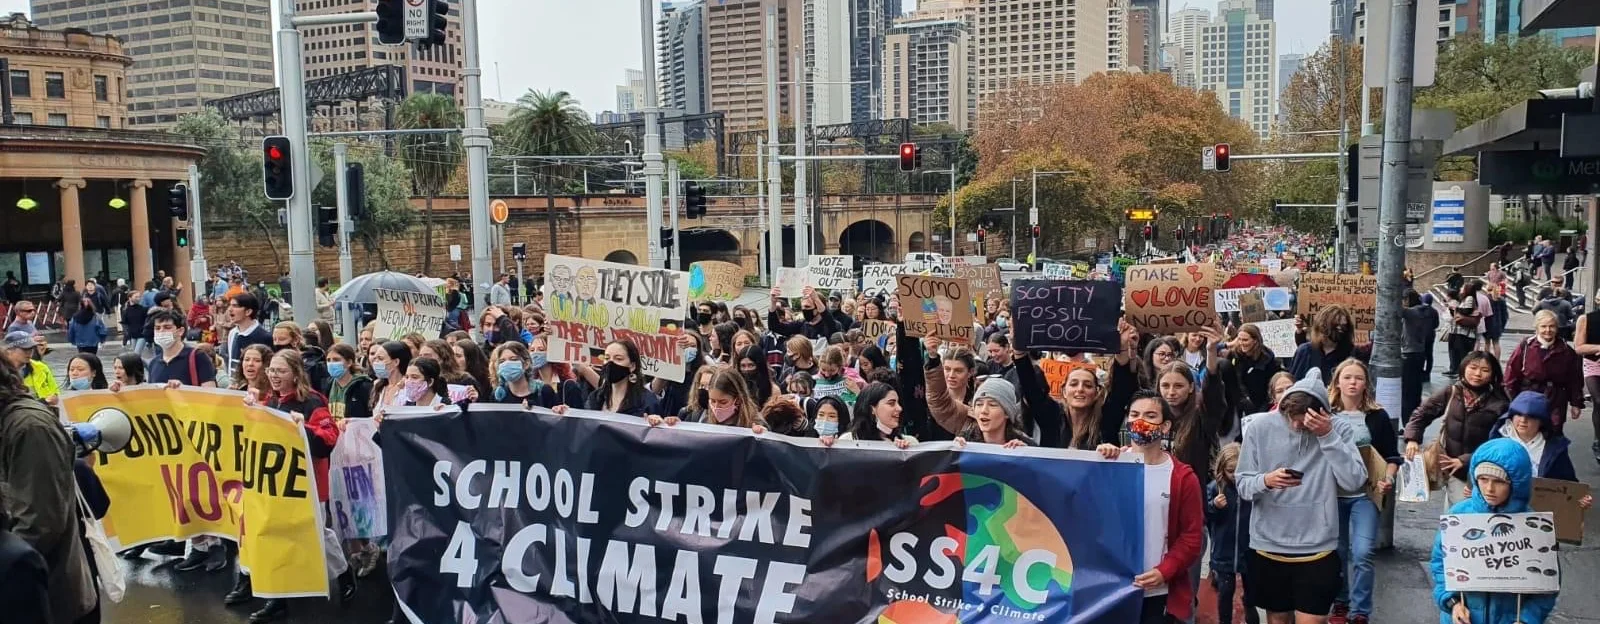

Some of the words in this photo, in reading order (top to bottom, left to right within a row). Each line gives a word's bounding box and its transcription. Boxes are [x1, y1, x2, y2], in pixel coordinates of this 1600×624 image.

[409, 9, 422, 18] NO
[818, 256, 844, 267] VOTE
[810, 267, 831, 276] FOSSIL
[864, 265, 909, 277] FRACK
[957, 266, 998, 280] SYSTEM
[1129, 267, 1180, 281] MAKE
[598, 268, 640, 305] THEY
[637, 269, 681, 309] STOLE
[818, 278, 842, 288] OUT
[875, 279, 892, 287] OFF
[900, 276, 961, 301] SCOMO
[970, 279, 993, 289] ANGE
[863, 287, 892, 297] GA
[1015, 285, 1095, 304] SCOTTY
[1150, 286, 1211, 307] LOVE
[413, 293, 443, 307] DRINK
[1222, 300, 1238, 311] ASS
[614, 306, 625, 327] &
[628, 307, 661, 334] NOW
[1017, 306, 1093, 321] FOSSIL
[904, 320, 928, 334] LIKES
[933, 323, 945, 336] IT
[950, 326, 972, 338] HOT
[1132, 314, 1171, 329] NOT
[1030, 323, 1099, 344] FOOL
[187, 420, 222, 471] UR
[233, 424, 307, 499] FURE
[432, 459, 599, 524] SCHOOL
[624, 476, 812, 548] STRIKE
[1461, 544, 1495, 559] OPEN
[1497, 537, 1534, 554] YOUR
[883, 532, 1057, 604] SS4C
[1485, 555, 1520, 571] EYES
[439, 520, 478, 588] 4
[502, 523, 808, 624] CLIMATE
[886, 588, 929, 604] School
[934, 595, 972, 612] Strike
[976, 603, 984, 613] 4
[990, 604, 1046, 622] Climate
